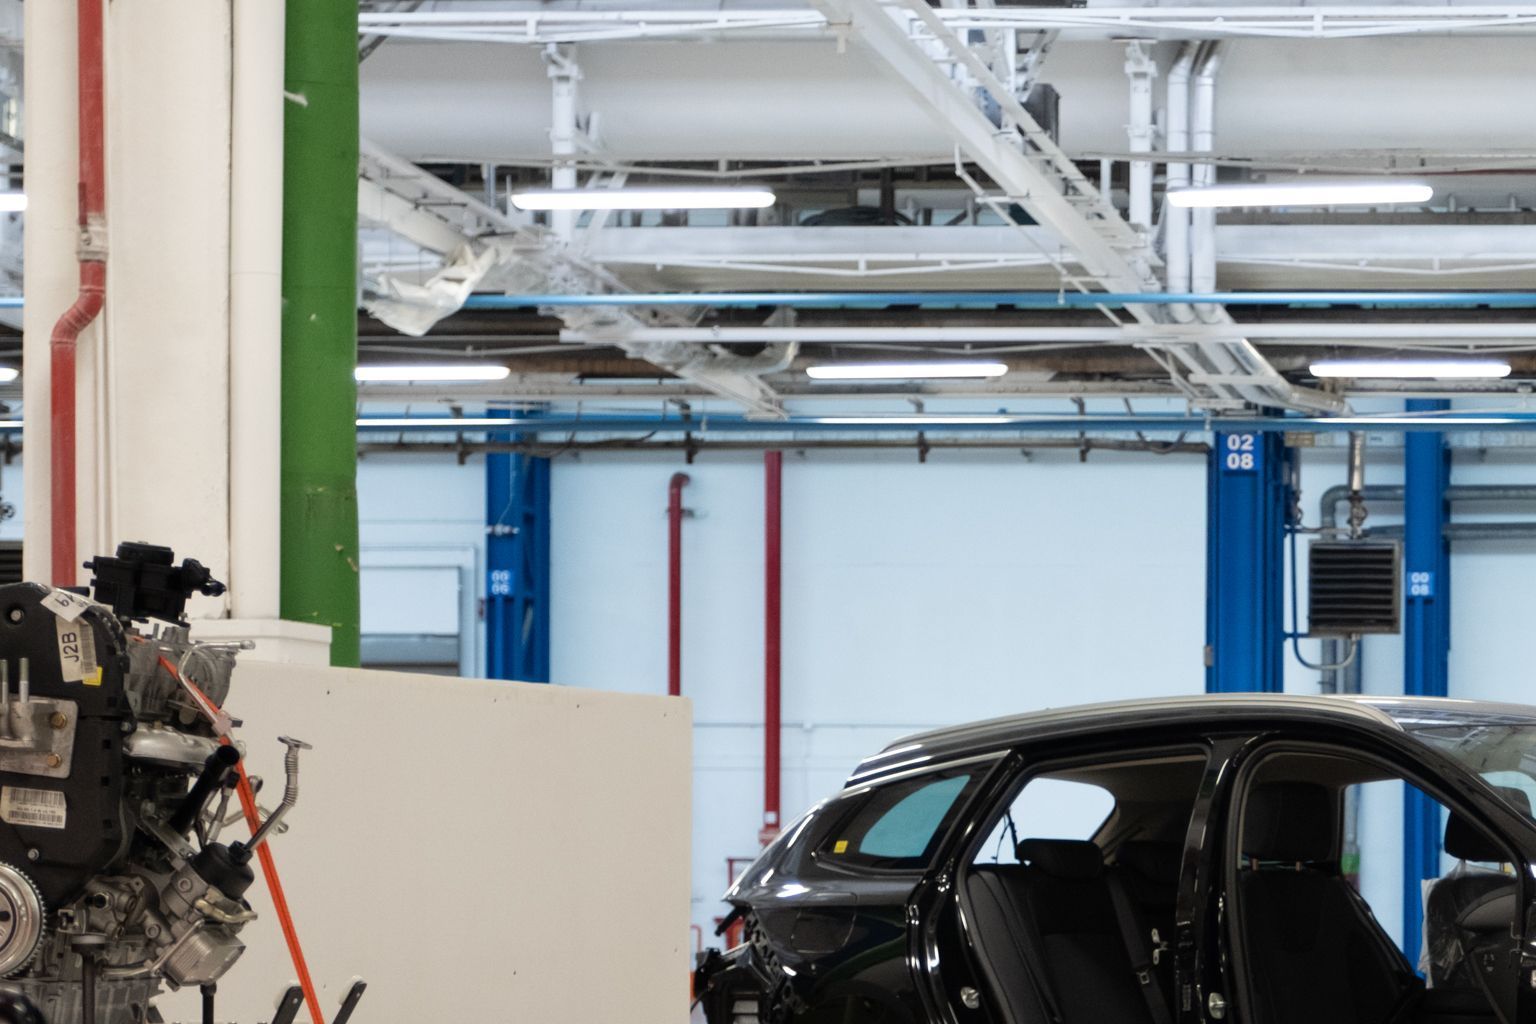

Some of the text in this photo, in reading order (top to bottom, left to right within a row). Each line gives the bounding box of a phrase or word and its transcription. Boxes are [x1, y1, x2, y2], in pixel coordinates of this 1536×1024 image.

[1227, 434, 1254, 450] 02
[1227, 453, 1254, 469] 08
[1411, 572, 1429, 583] 00
[62, 631, 80, 663] J2B
